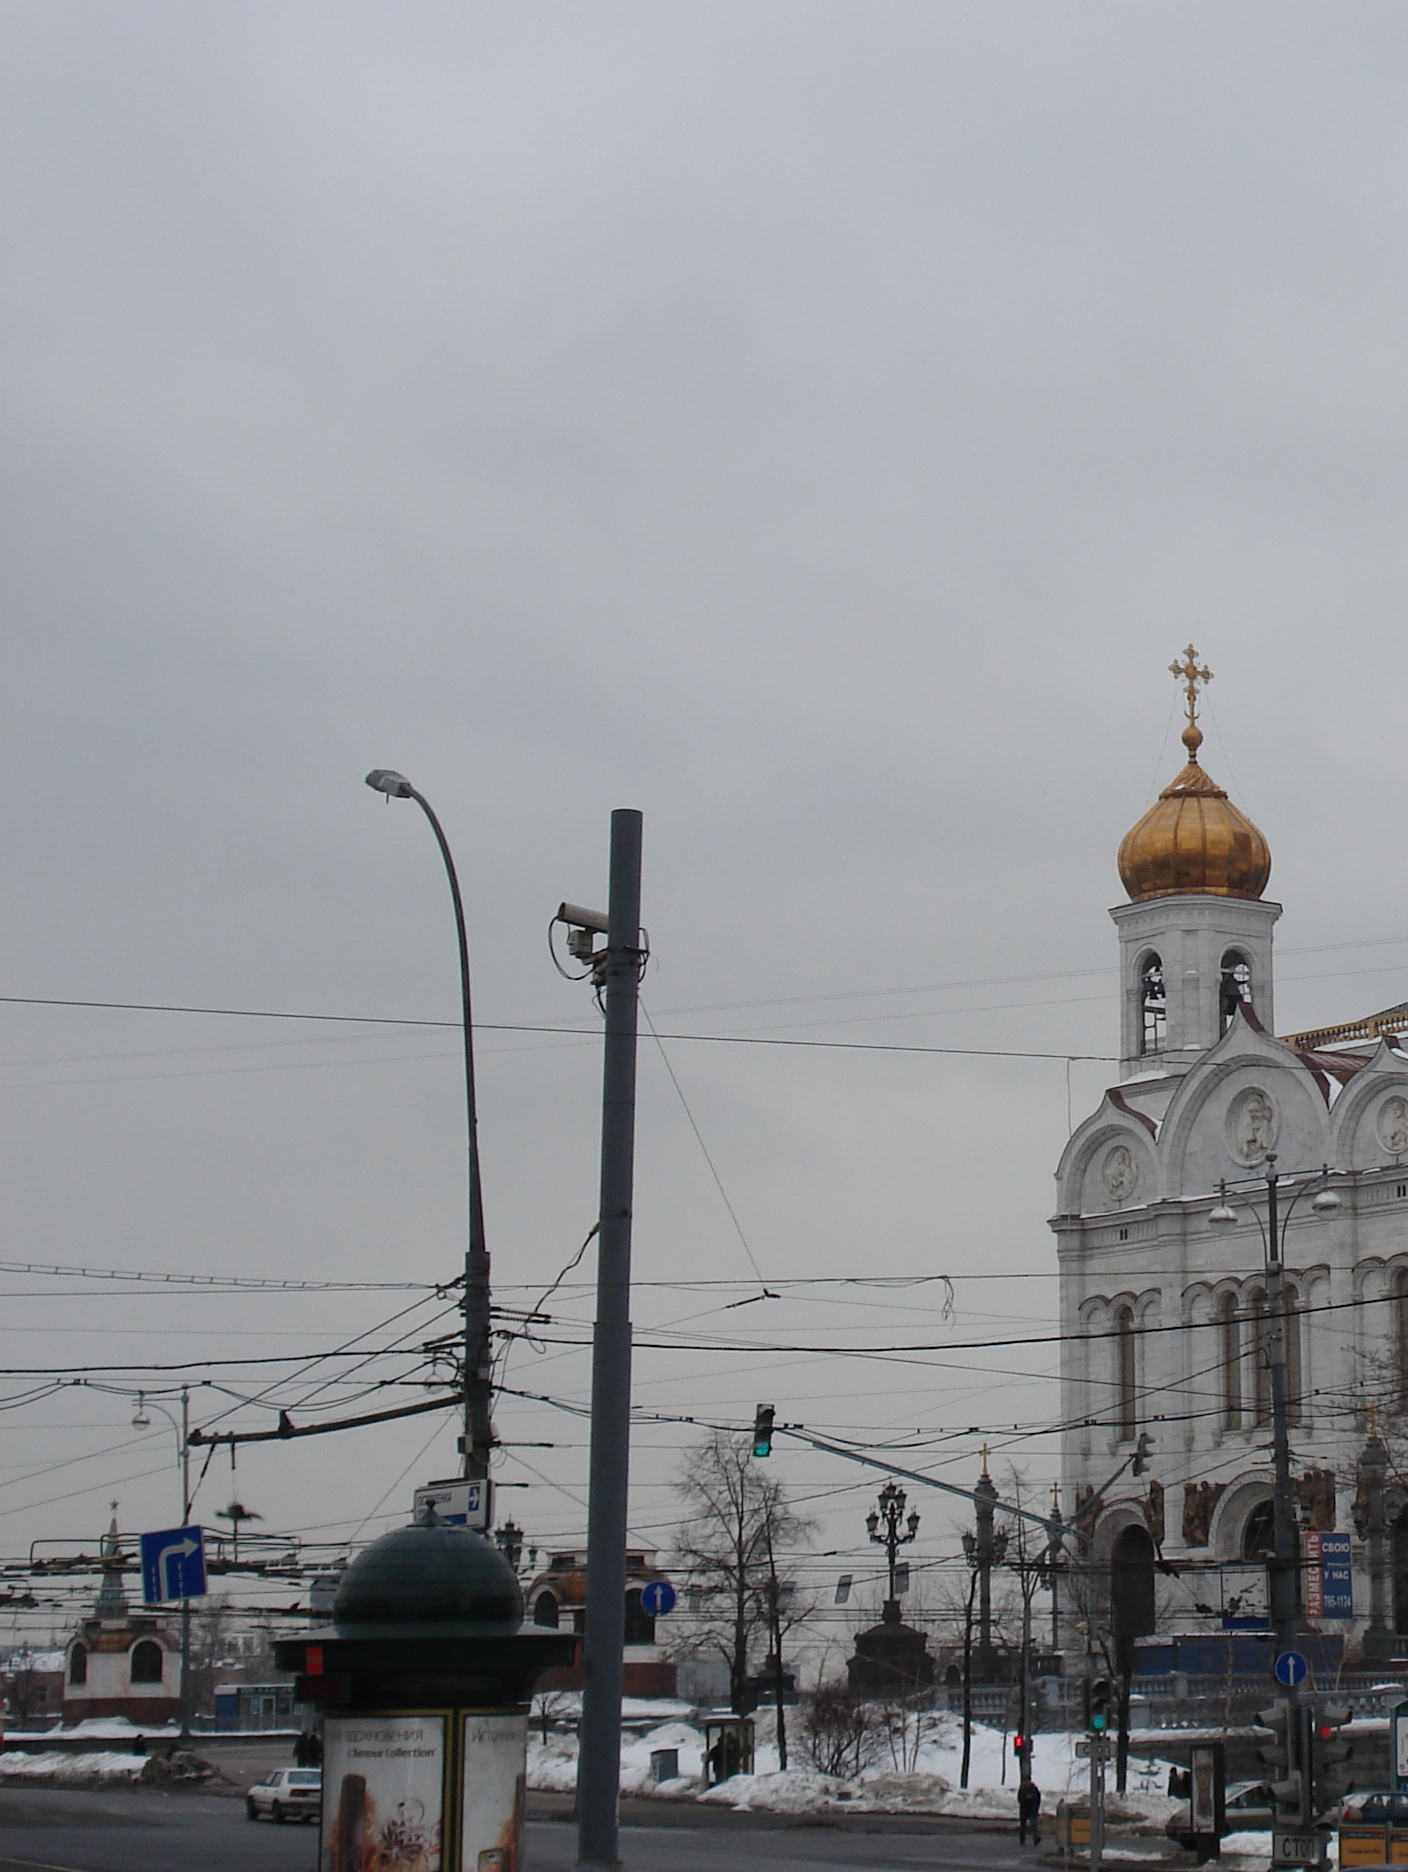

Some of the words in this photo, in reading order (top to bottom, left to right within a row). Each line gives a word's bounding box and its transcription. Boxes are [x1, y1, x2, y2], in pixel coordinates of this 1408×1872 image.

[1322, 1542, 1350, 1553] СВОЮ
[1323, 1571, 1331, 1580] У
[1332, 1571, 1349, 1580] НАС
